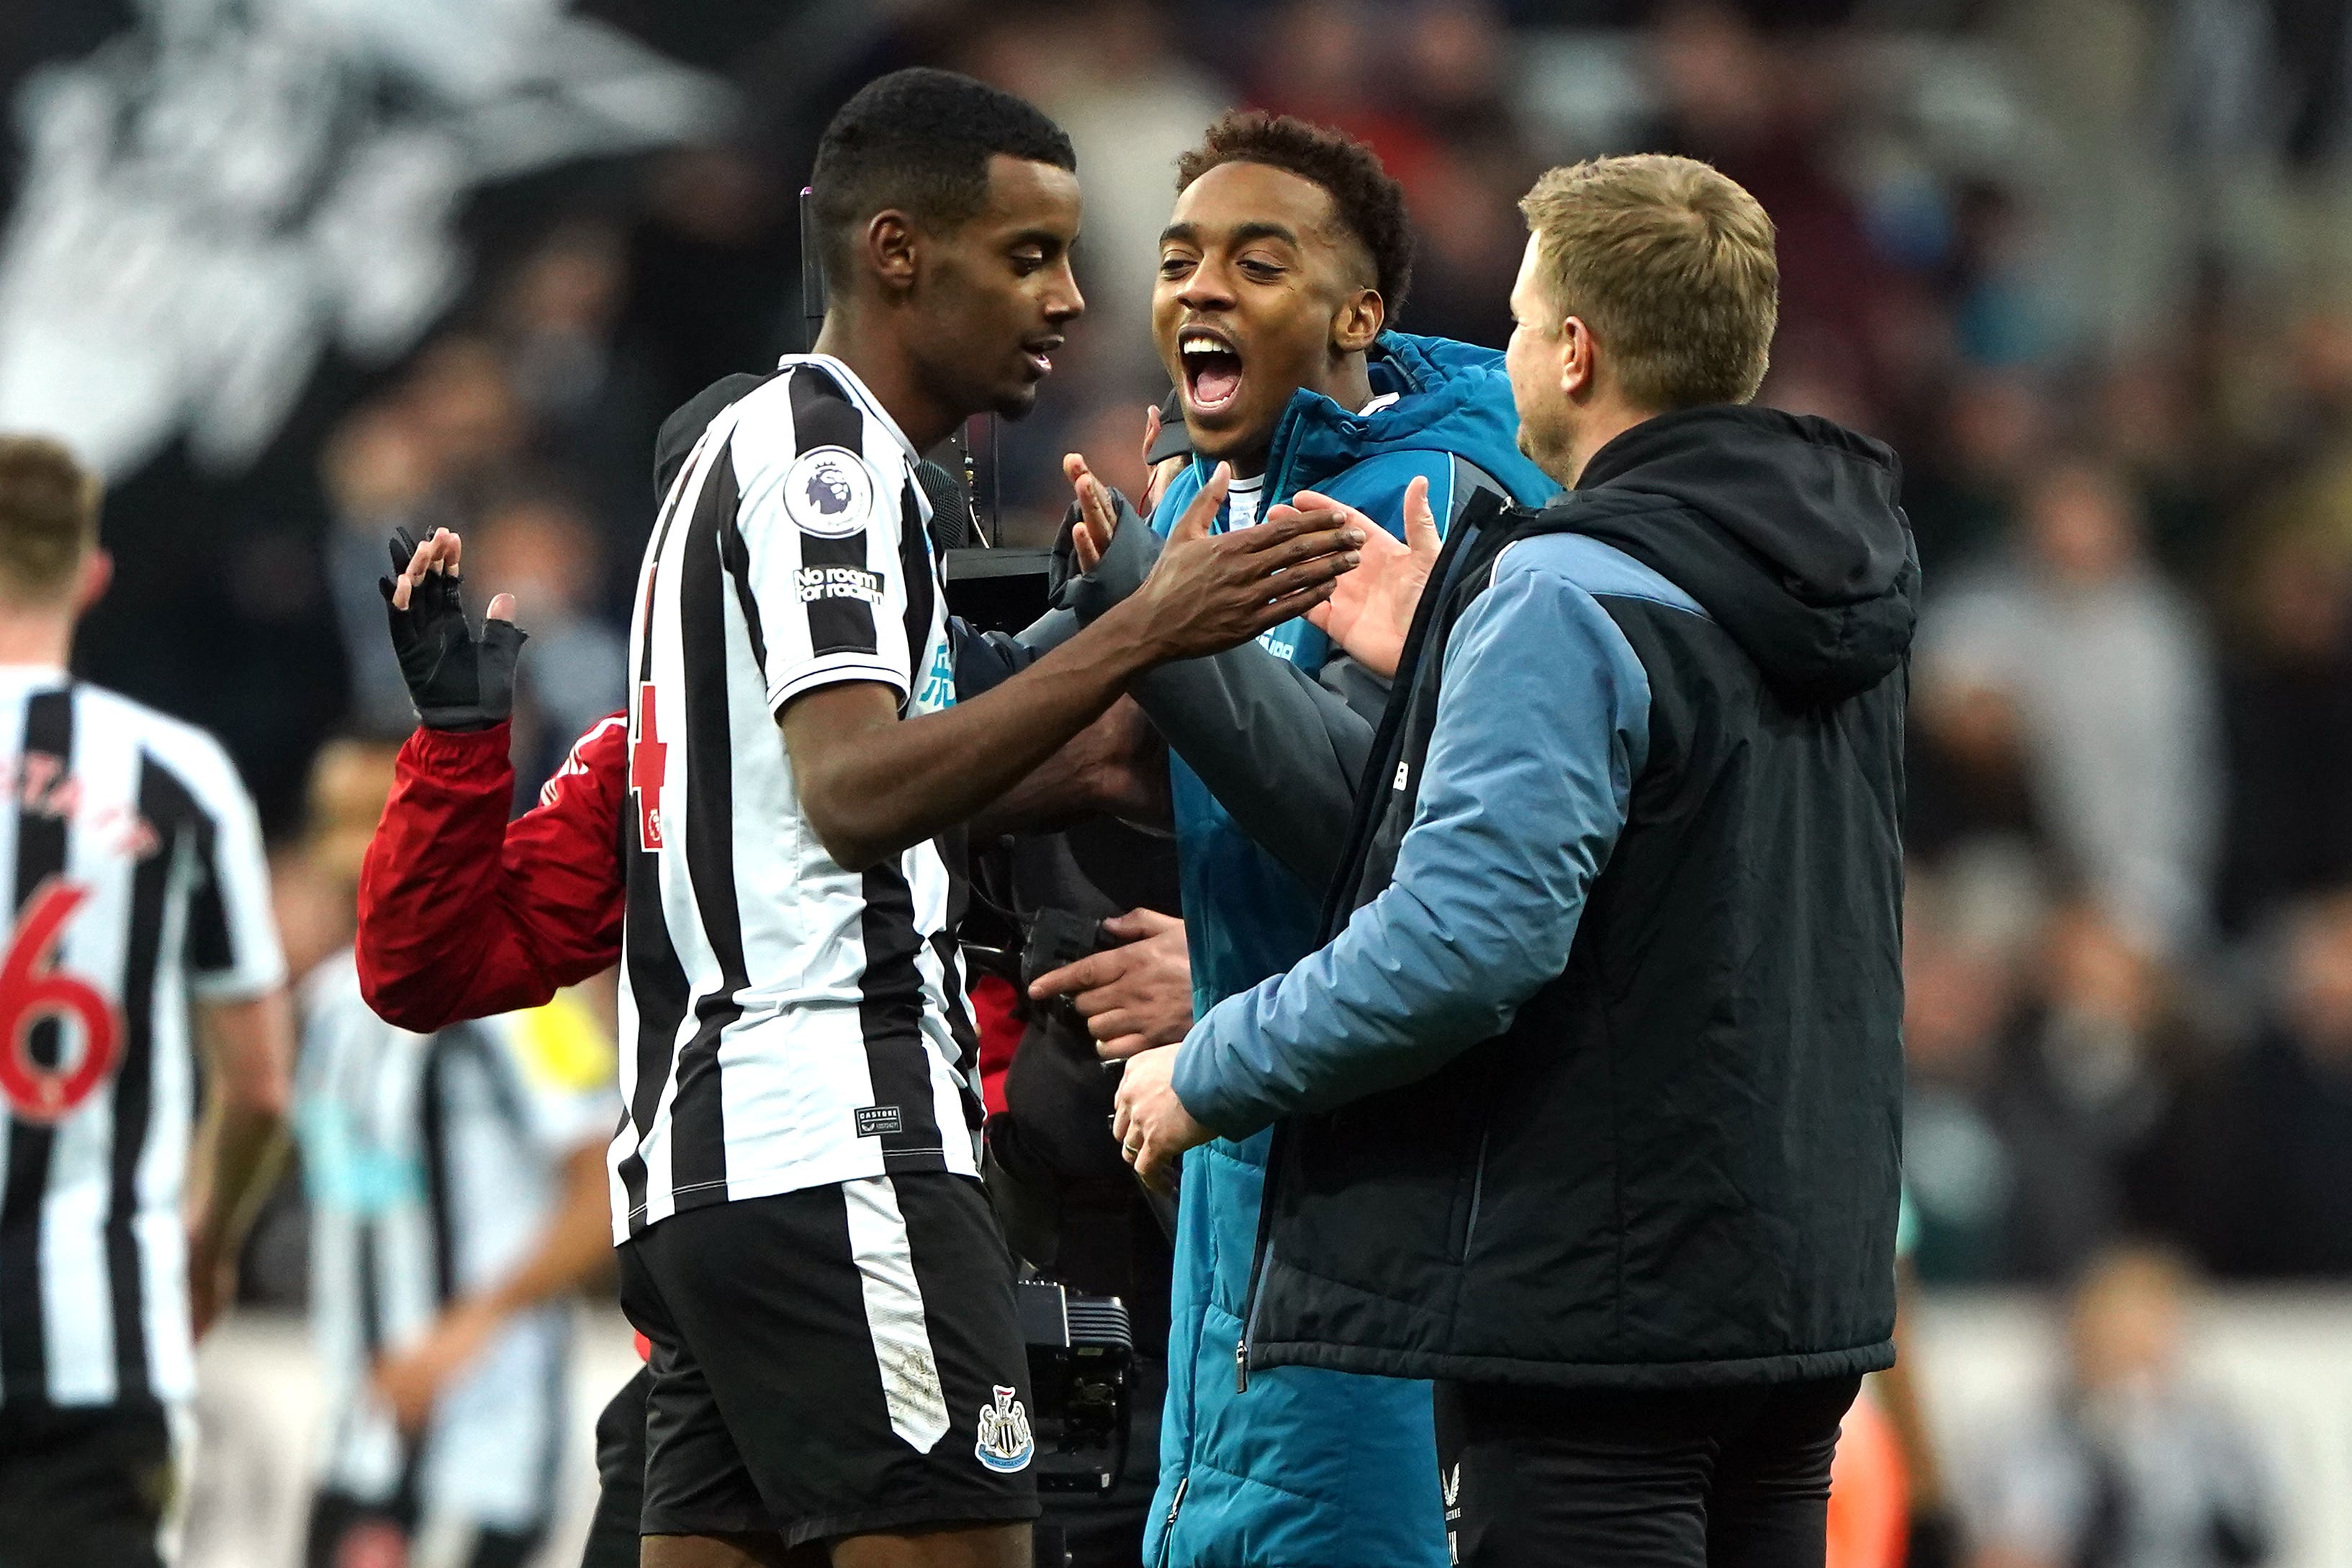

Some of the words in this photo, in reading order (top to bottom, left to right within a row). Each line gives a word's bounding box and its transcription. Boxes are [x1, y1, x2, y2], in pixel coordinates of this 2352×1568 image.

[793, 567, 824, 588] No
[826, 567, 878, 590] room
[860, 1109, 898, 1119] CASTORE
